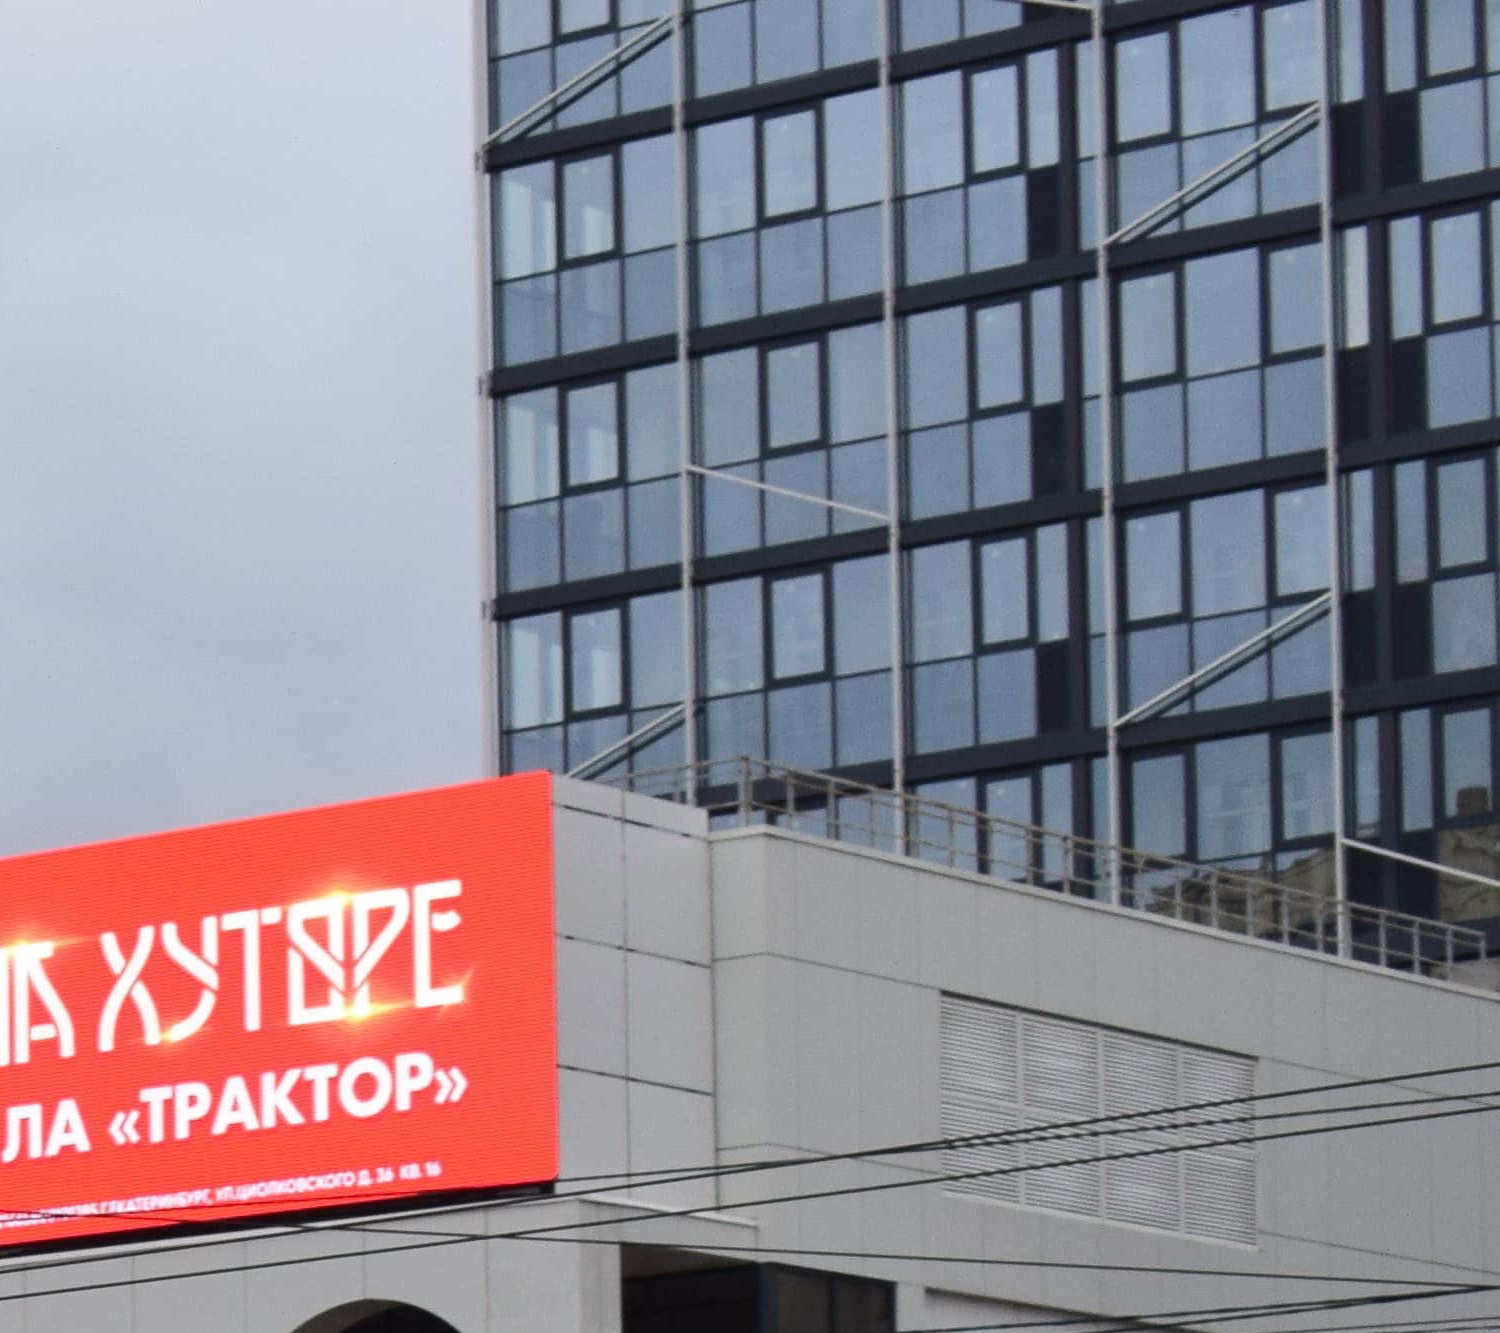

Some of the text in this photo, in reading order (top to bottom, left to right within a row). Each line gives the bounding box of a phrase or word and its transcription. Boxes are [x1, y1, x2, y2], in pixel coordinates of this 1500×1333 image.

[99, 879, 464, 1054] ХУТОРЕ
[1, 1099, 91, 1164] ЛА
[108, 1049, 469, 1152] «ТРАКТОР»
